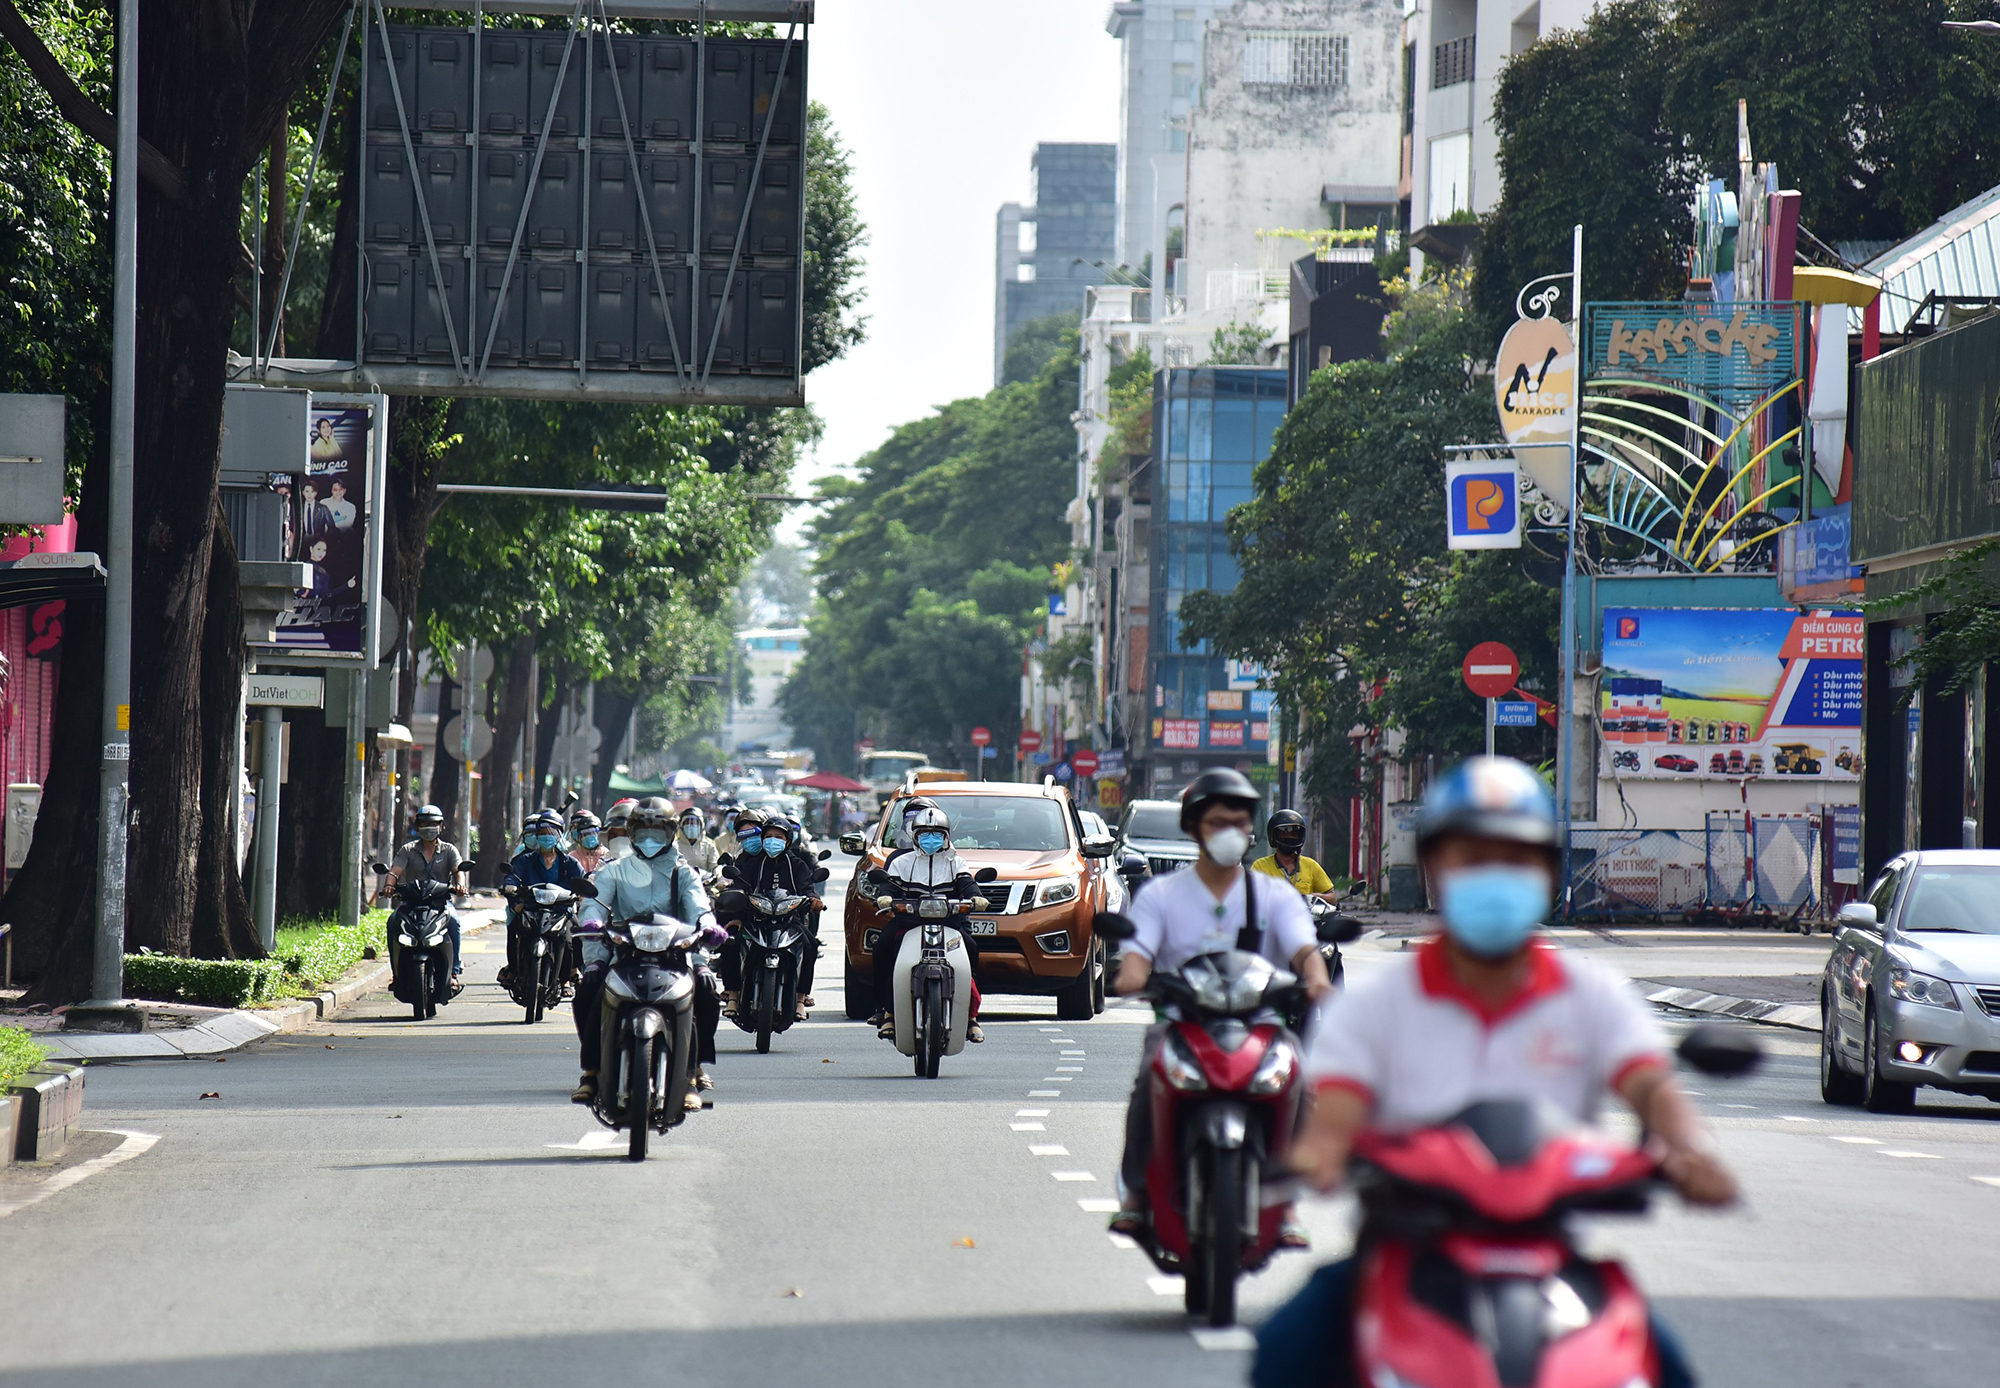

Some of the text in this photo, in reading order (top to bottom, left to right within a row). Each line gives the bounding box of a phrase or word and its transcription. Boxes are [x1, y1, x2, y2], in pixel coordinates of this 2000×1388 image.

[1608, 311, 1780, 365] KARAOKE
[327, 460, 348, 470] CAO
[1826, 622, 1851, 634] CUNG
[1500, 715, 1533, 723] PASTEUR
